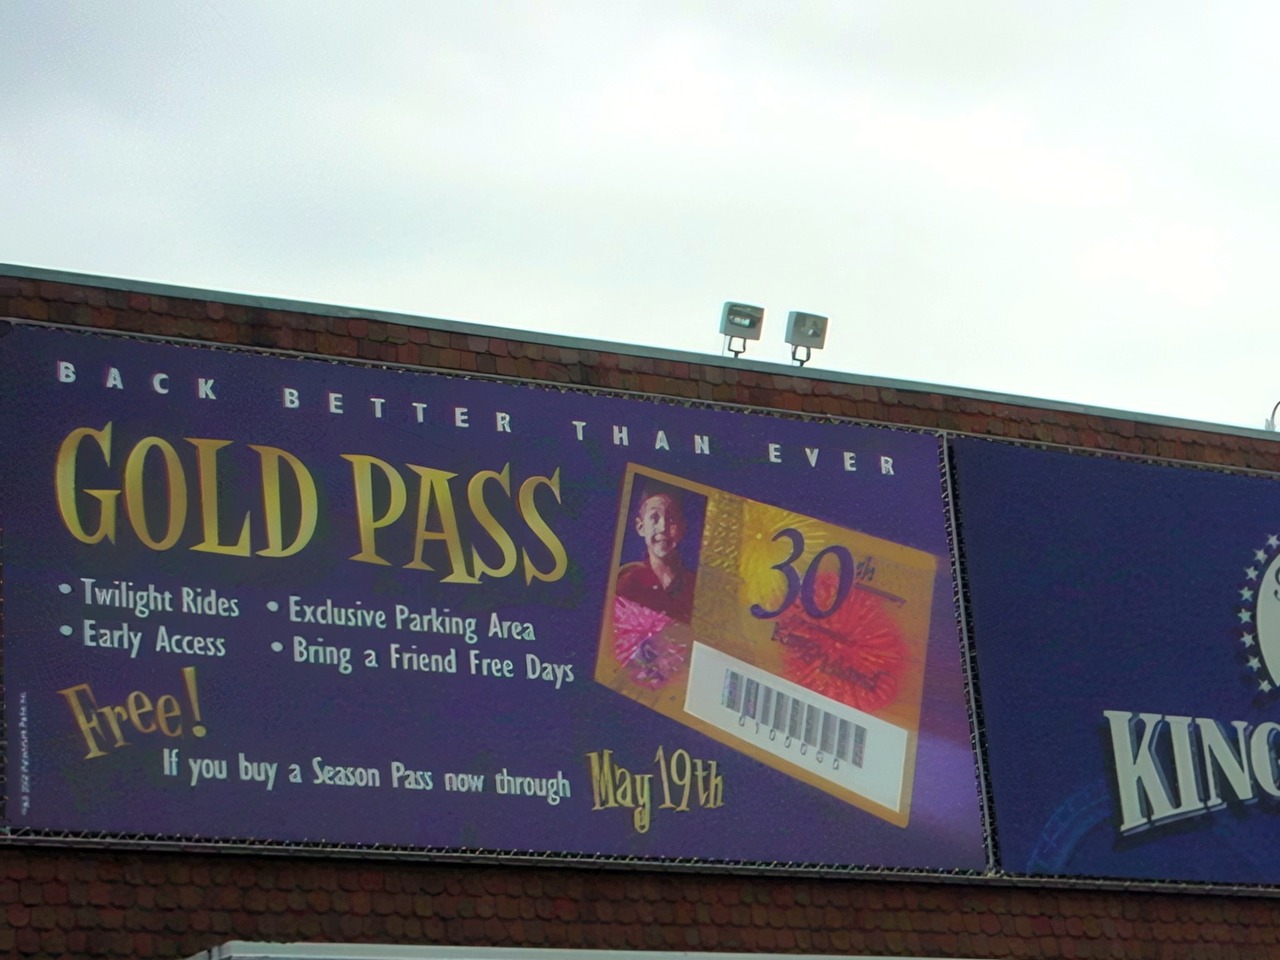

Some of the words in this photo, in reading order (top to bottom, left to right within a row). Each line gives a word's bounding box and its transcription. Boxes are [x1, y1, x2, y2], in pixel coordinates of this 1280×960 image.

[56, 360, 218, 400] BACK
[283, 387, 513, 434] BETTER
[572, 420, 711, 455] THAN
[768, 442, 896, 476] EVER
[55, 420, 319, 558] GOLD
[339, 453, 569, 587] PASS
[80, 577, 173, 617] Twilight
[181, 588, 240, 618] Rides
[288, 595, 387, 630] Exclusive
[395, 605, 478, 643] Parking
[488, 611, 536, 642] Area
[82, 619, 142, 658] Early
[155, 624, 227, 657] Access
[292, 638, 353, 675] Bring
[364, 649, 379, 669] a
[390, 643, 457, 674] Friend
[469, 649, 515, 679] Free
[525, 653, 576, 690] Days
[57, 666, 208, 760] Free!
[162, 748, 179, 777] If
[188, 756, 228, 786] you
[238, 752, 279, 791] buy
[288, 763, 303, 784] a
[311, 757, 381, 789] Season
[390, 761, 434, 791] Pass
[443, 771, 484, 794] now
[494, 769, 572, 806] through
[586, 749, 653, 834] May
[653, 745, 725, 813] 19th
